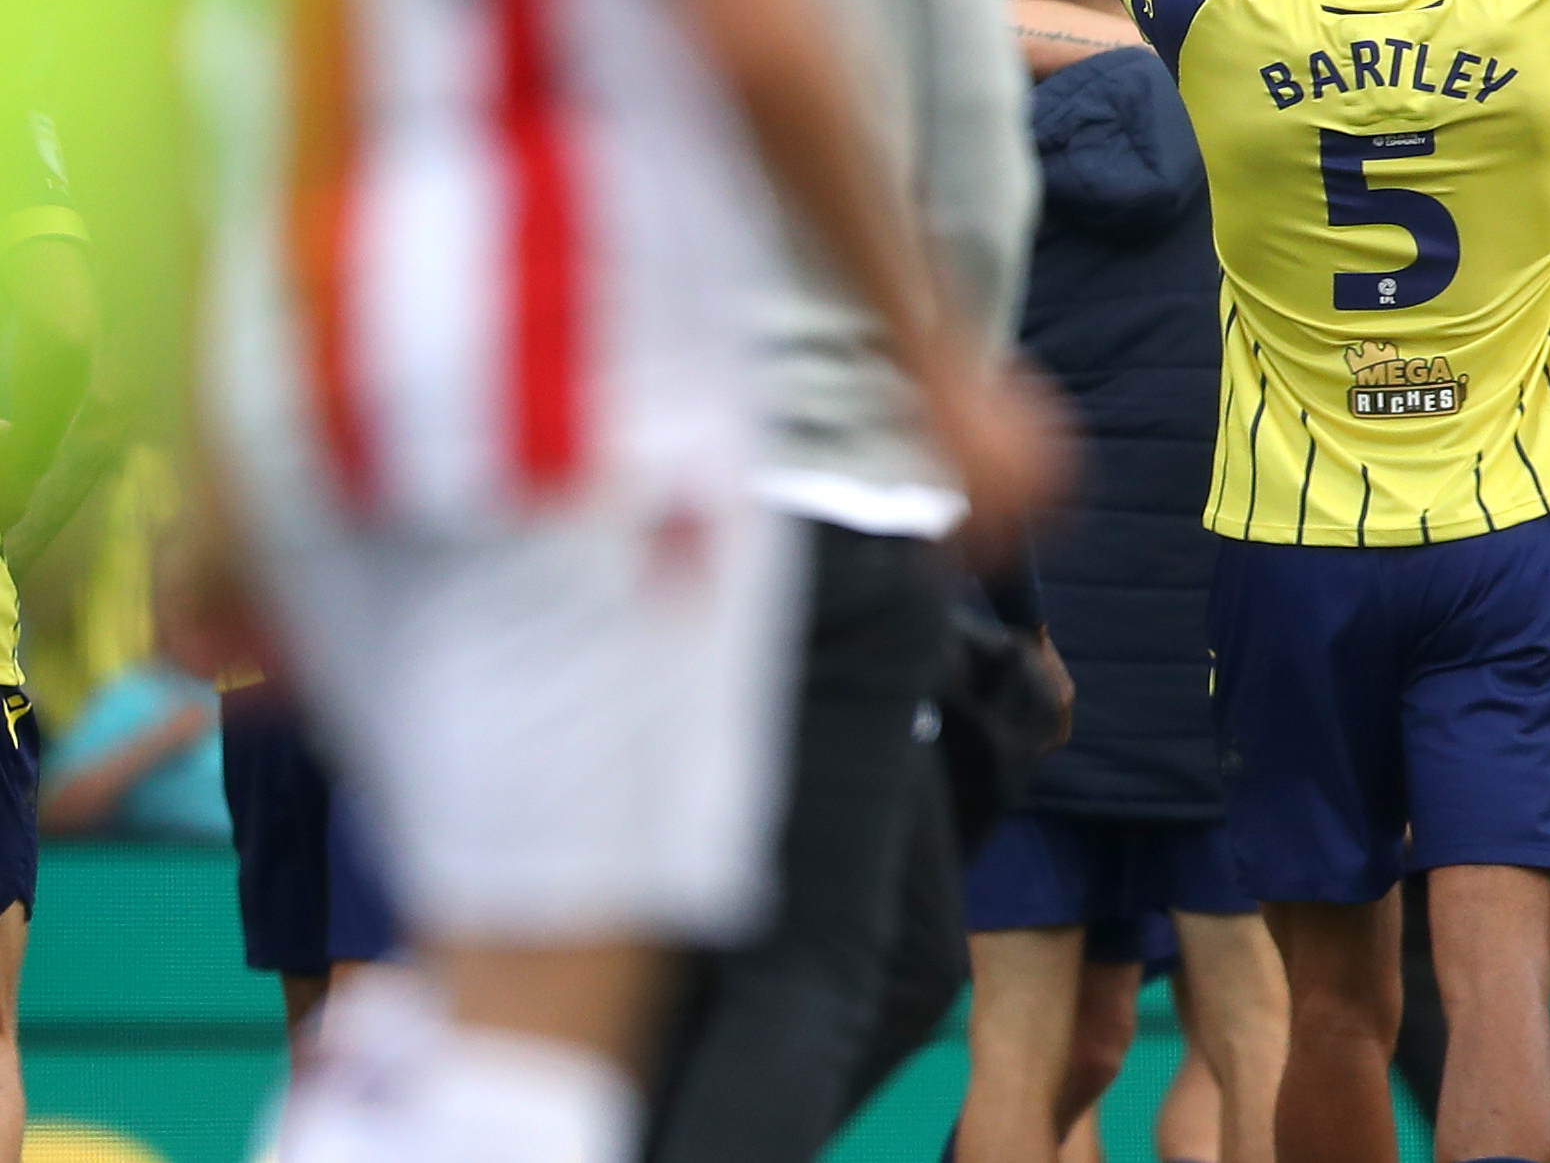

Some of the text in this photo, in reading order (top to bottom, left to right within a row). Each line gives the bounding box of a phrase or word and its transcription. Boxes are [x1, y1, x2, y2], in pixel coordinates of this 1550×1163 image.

[1260, 38, 1518, 110] BARTLEY
[1319, 129, 1460, 311] 5
[1357, 356, 1454, 386] MEGA
[1357, 389, 1454, 413] RICHES
